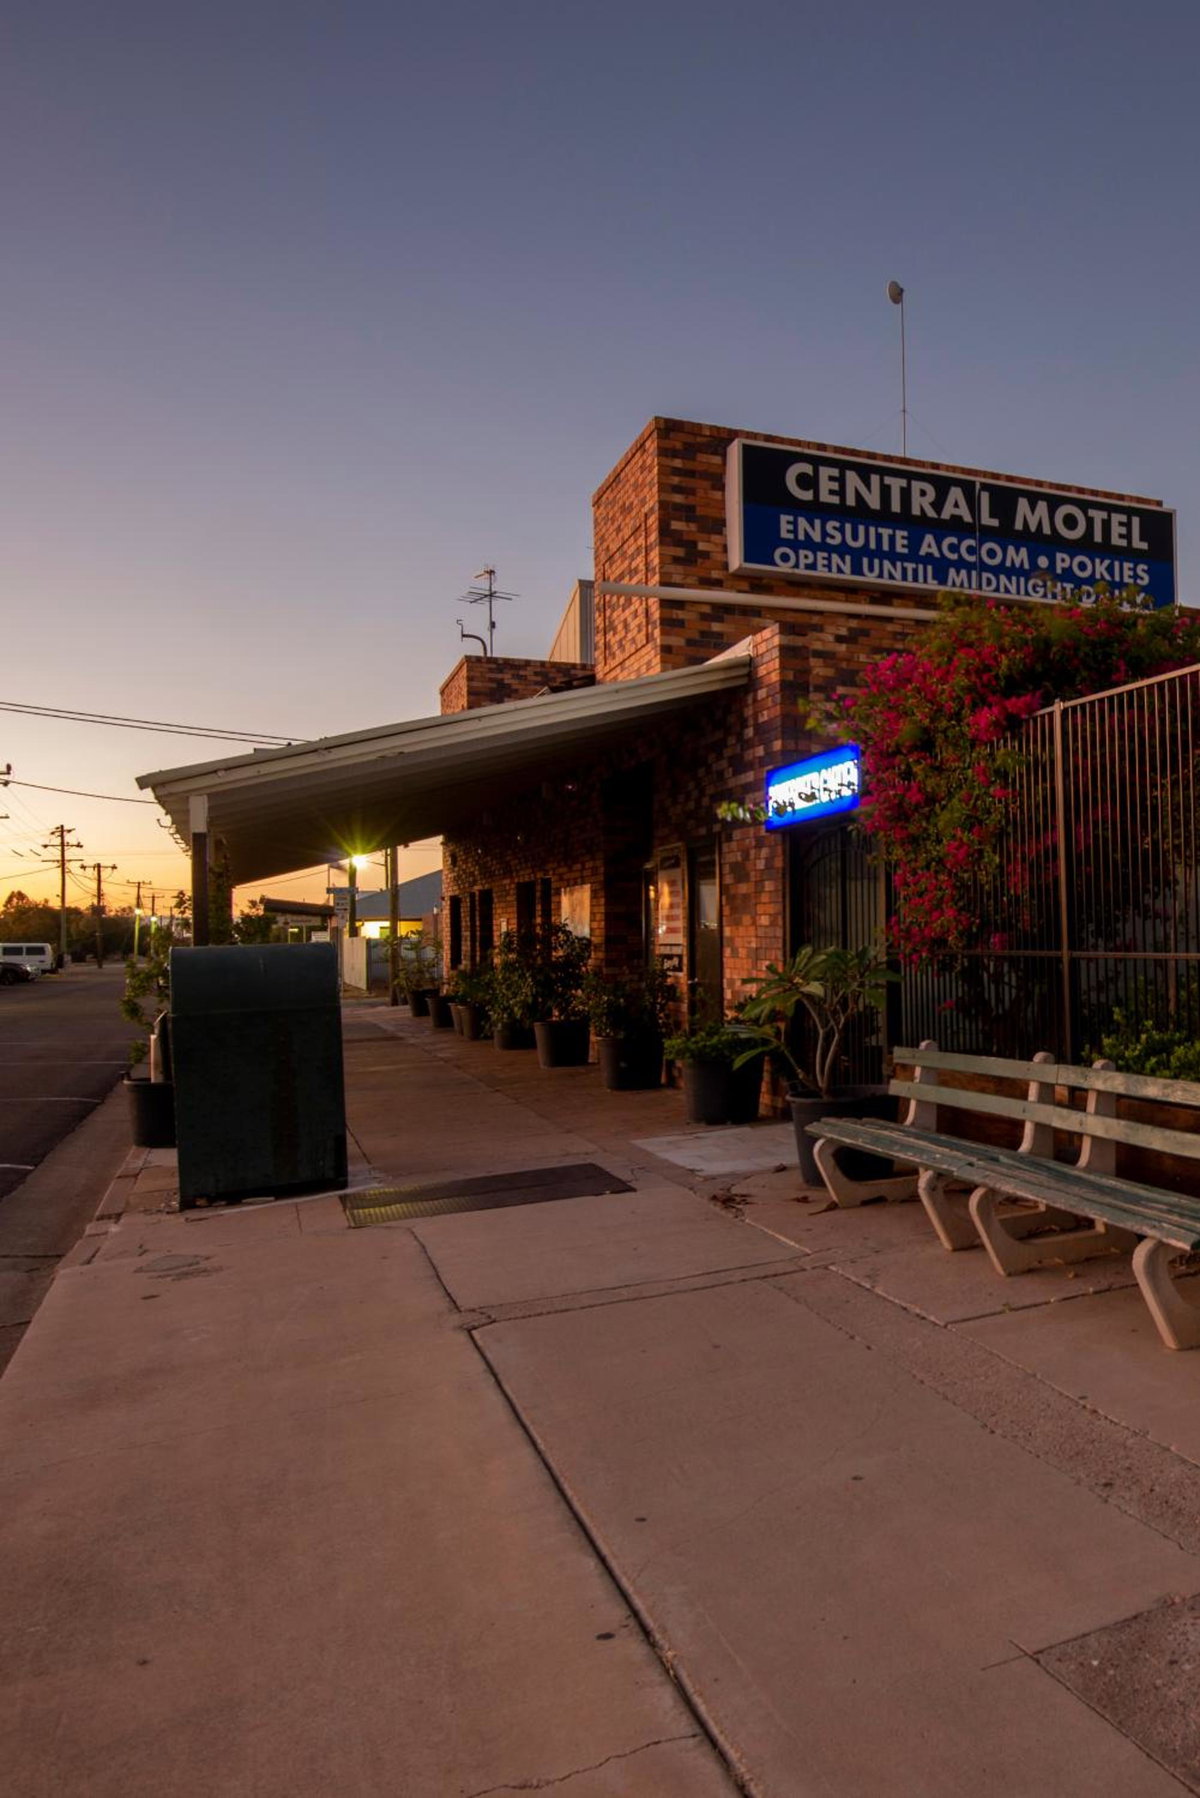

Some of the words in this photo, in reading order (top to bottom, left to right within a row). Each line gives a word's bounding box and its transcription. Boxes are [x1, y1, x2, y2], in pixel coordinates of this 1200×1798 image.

[785, 462, 1000, 528] CENTRAL
[1014, 496, 1149, 550] MOTEL
[773, 546, 851, 576] OPEN
[862, 556, 938, 585] UNTIL
[947, 567, 1075, 601] MIDNIGHT
[779, 514, 909, 554] ENSUITE
[918, 533, 1030, 570] ACCOM
[1055, 551, 1150, 586] POKIES
